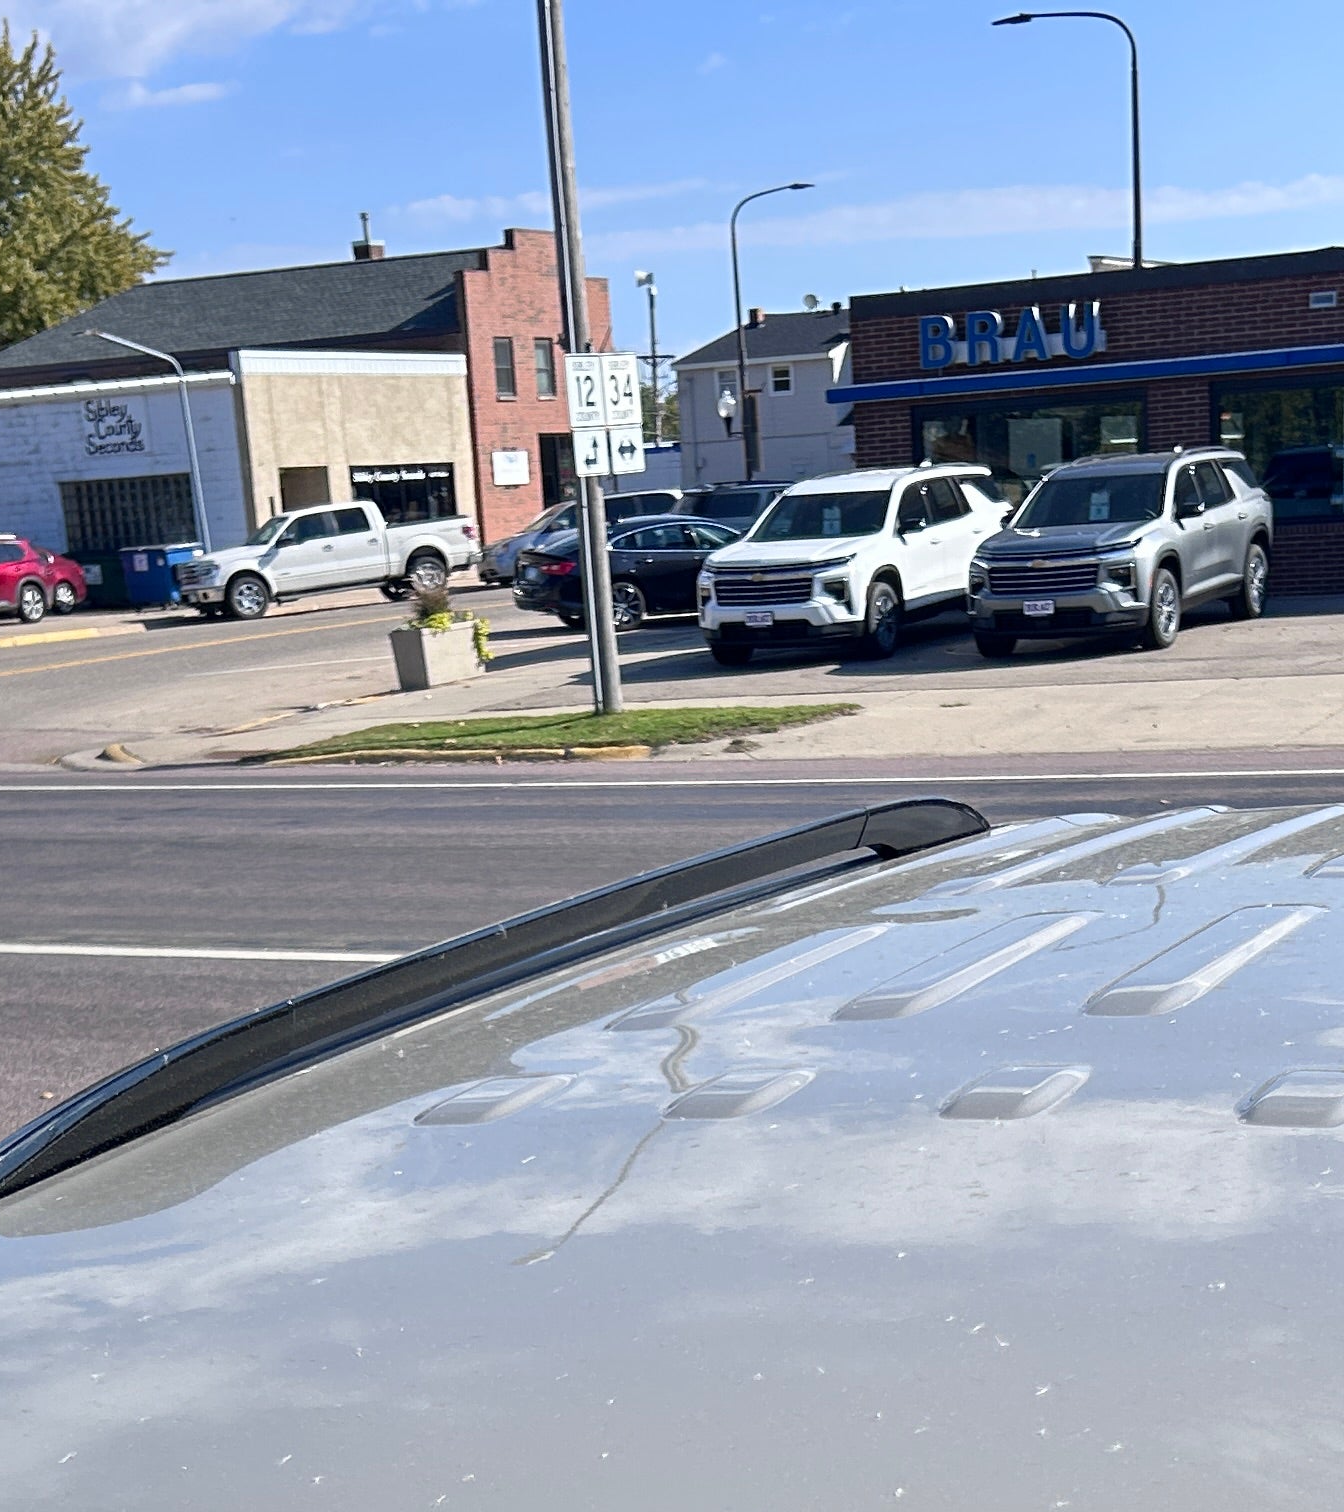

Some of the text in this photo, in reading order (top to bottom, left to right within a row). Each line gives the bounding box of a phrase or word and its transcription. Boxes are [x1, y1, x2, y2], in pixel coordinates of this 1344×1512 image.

[920, 301, 1099, 370] BRAU
[576, 375, 597, 407] 12
[609, 373, 633, 406] 34
